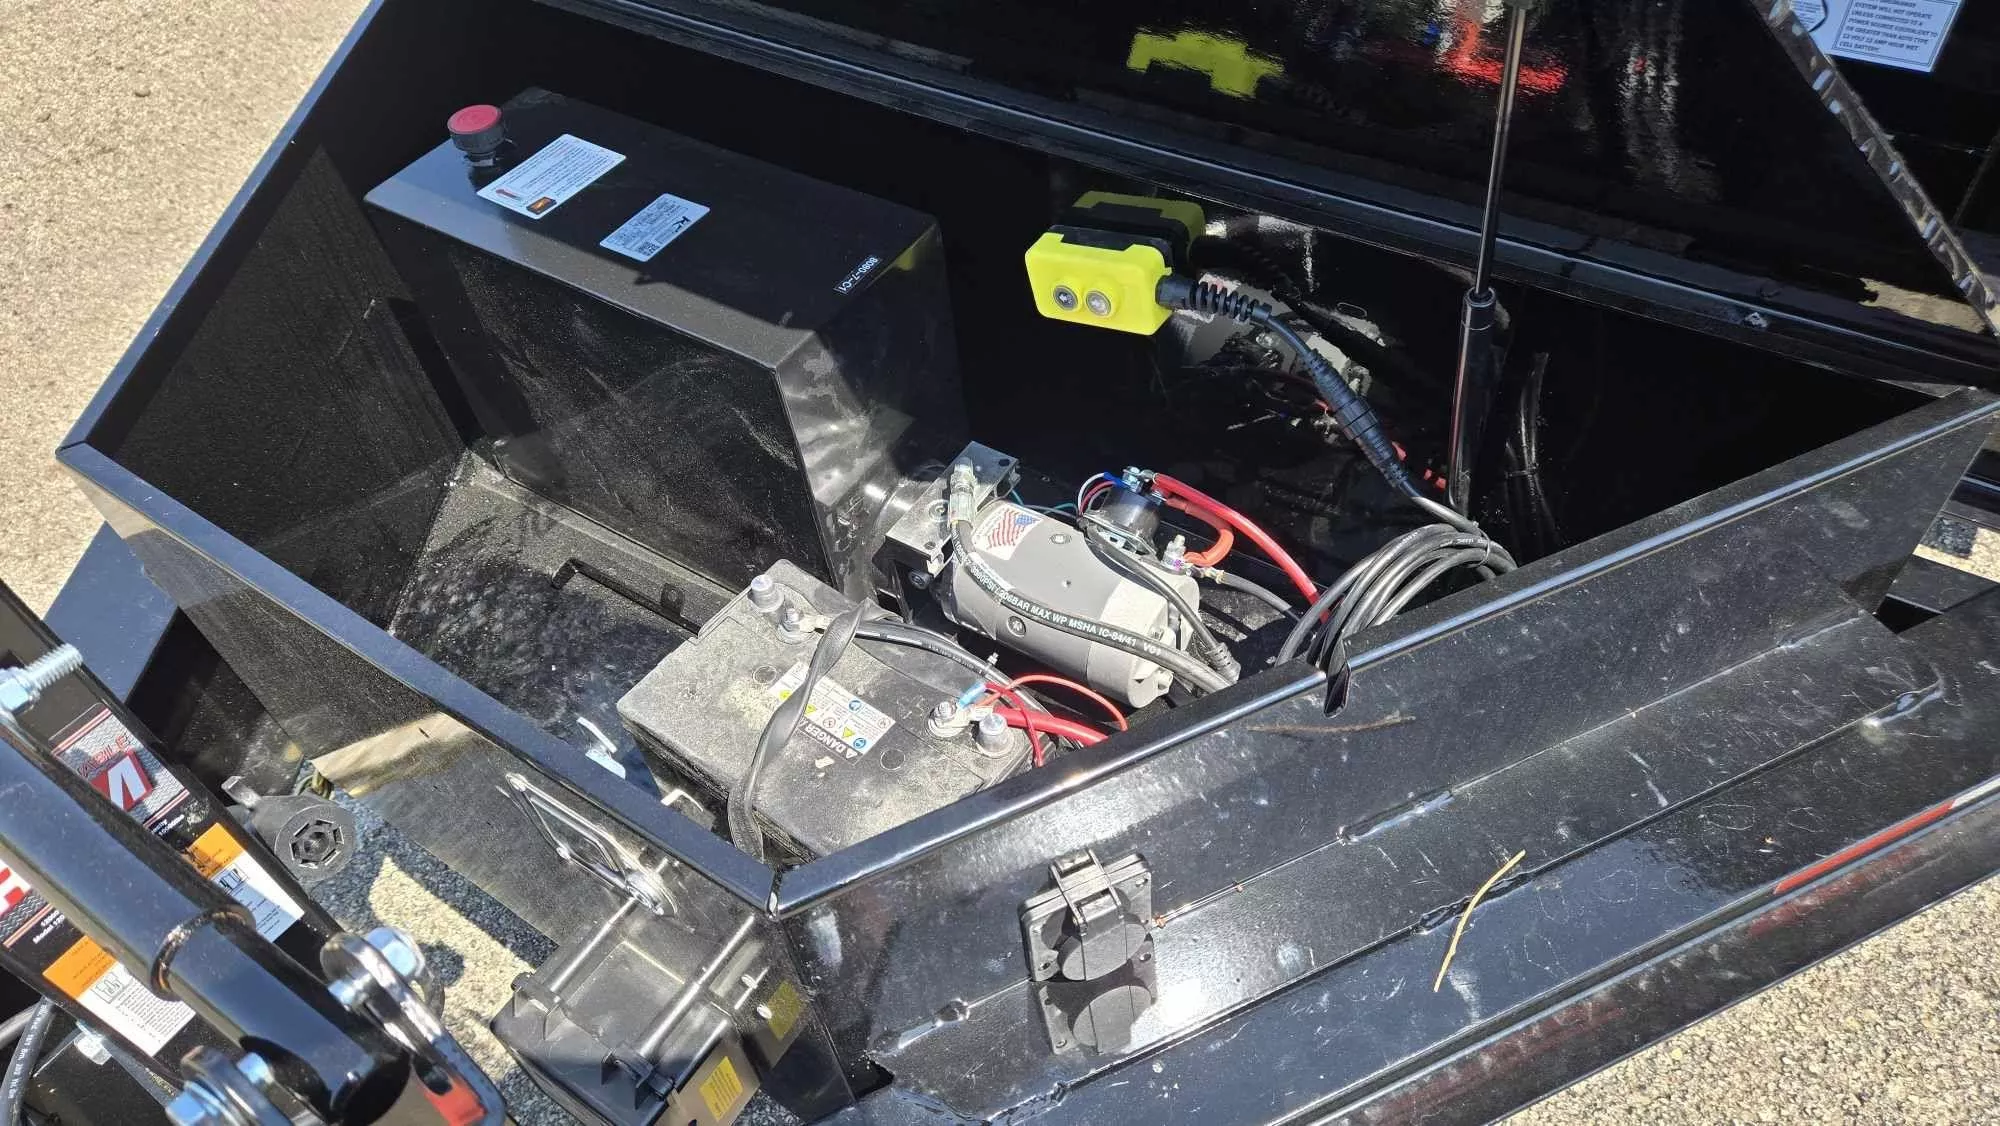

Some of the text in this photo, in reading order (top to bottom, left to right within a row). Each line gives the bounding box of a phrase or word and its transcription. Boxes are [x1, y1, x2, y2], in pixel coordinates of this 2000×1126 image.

[1030, 605, 1050, 621] MAX
[1051, 611, 1068, 626] WP
[1068, 618, 1097, 634] MSHA
[803, 722, 847, 754] DANGER
